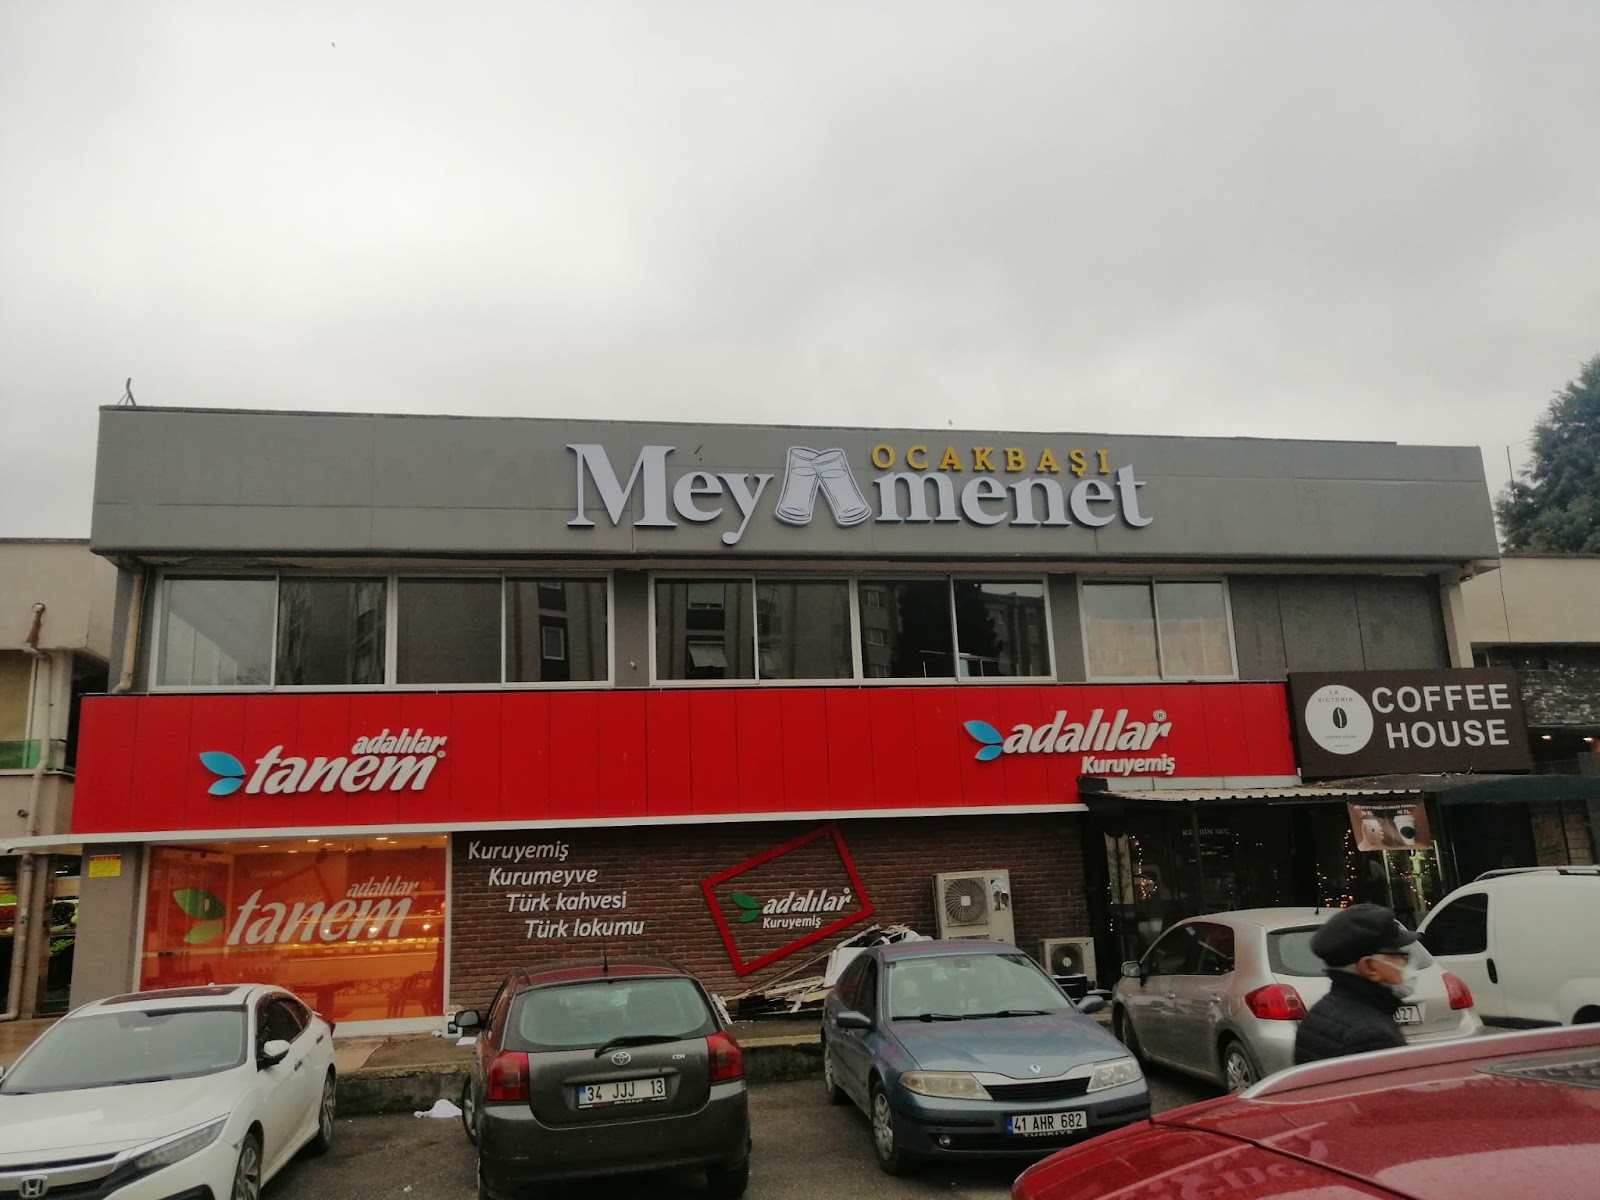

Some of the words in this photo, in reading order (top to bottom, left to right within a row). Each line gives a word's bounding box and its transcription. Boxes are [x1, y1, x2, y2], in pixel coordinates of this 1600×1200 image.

[871, 444, 1110, 476] OCAKBAŞI
[1371, 683, 1512, 714] COFFEE
[1385, 719, 1510, 749] HOUSE
[245, 745, 437, 794] tanem
[1081, 753, 1176, 776] Kuruyemiş
[468, 840, 569, 863] Kuruyemiş
[488, 867, 598, 887] Kurumeyve
[506, 892, 551, 913] Türk
[555, 890, 627, 911] kahvesi
[227, 888, 413, 945] tanem
[762, 915, 821, 930] Kuruyemiş
[525, 918, 568, 939] Türk
[573, 918, 645, 937] lokumu
[587, 1085, 602, 1102] 34
[612, 1081, 635, 1099] JJJ
[650, 1079, 664, 1095] 13
[1014, 1117, 1027, 1131] 41
[1032, 1115, 1054, 1130] AHR
[1061, 1113, 1082, 1128] 682
